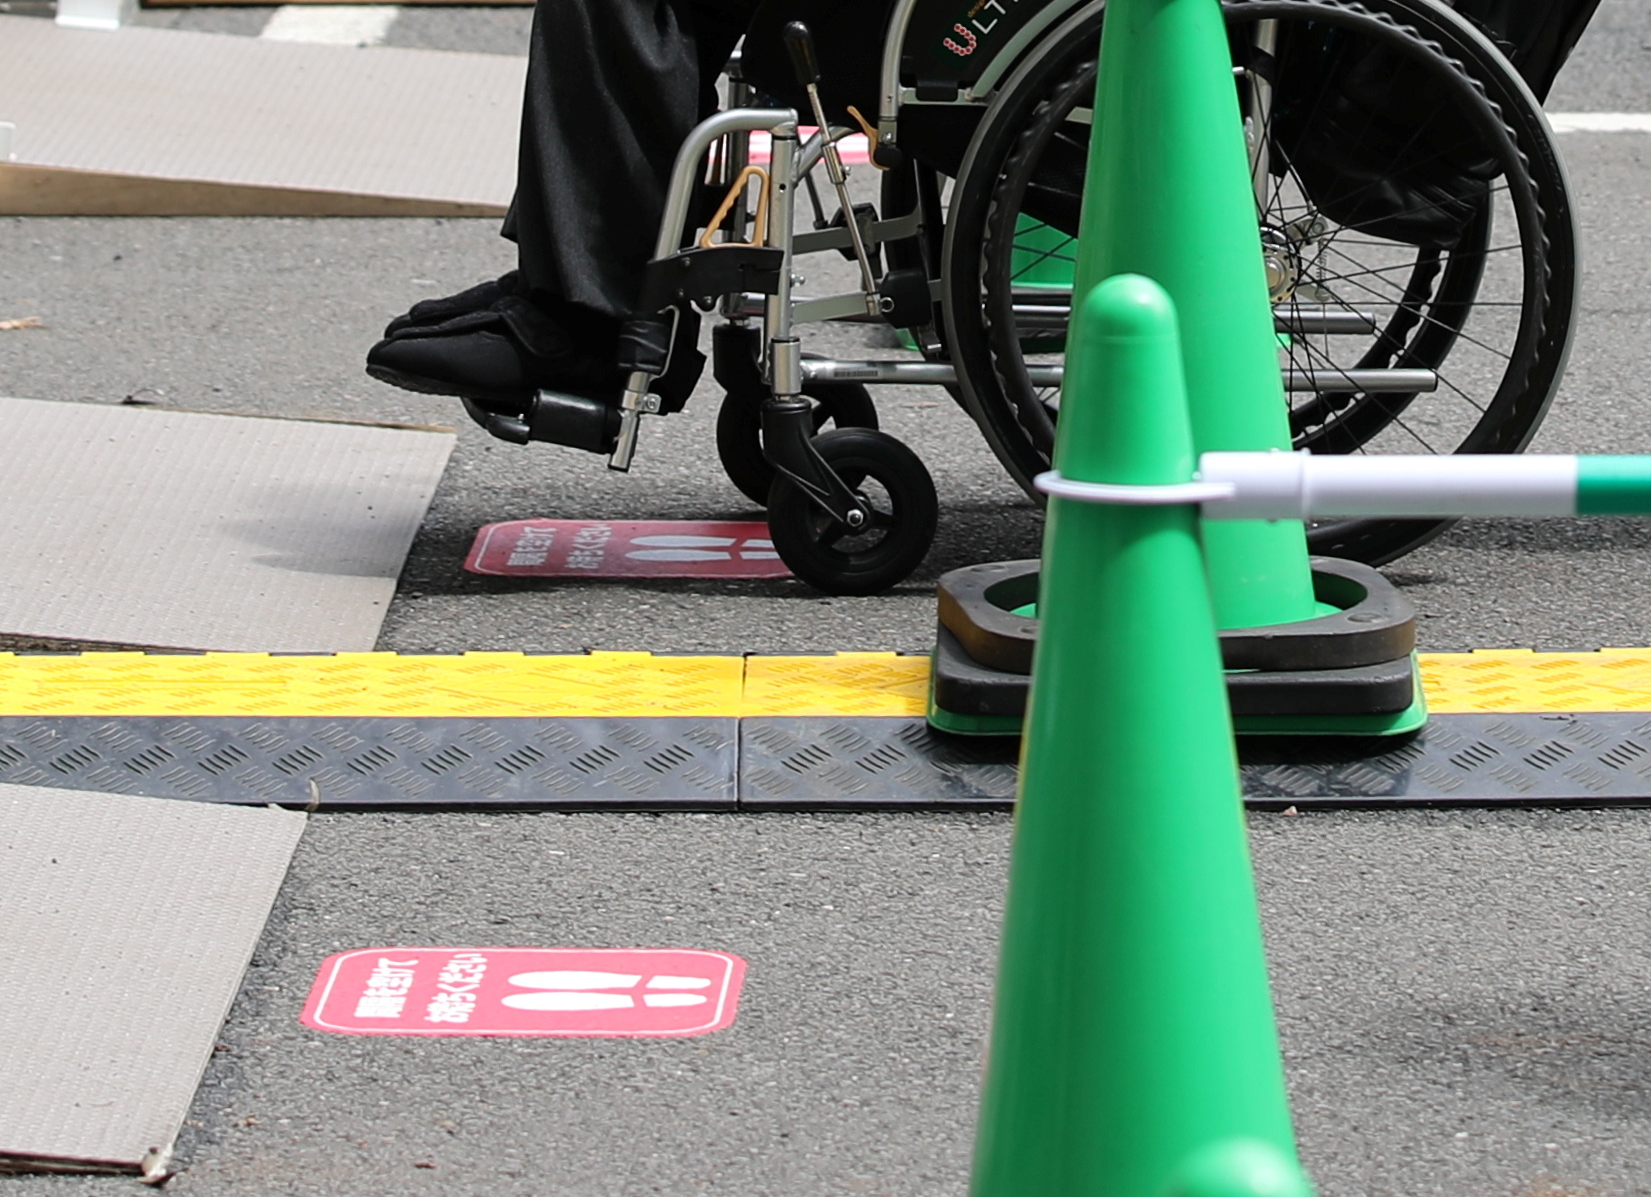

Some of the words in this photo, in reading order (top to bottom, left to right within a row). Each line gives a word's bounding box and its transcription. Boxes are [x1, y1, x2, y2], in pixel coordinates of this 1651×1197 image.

[423, 953, 488, 1023] お待ちください
